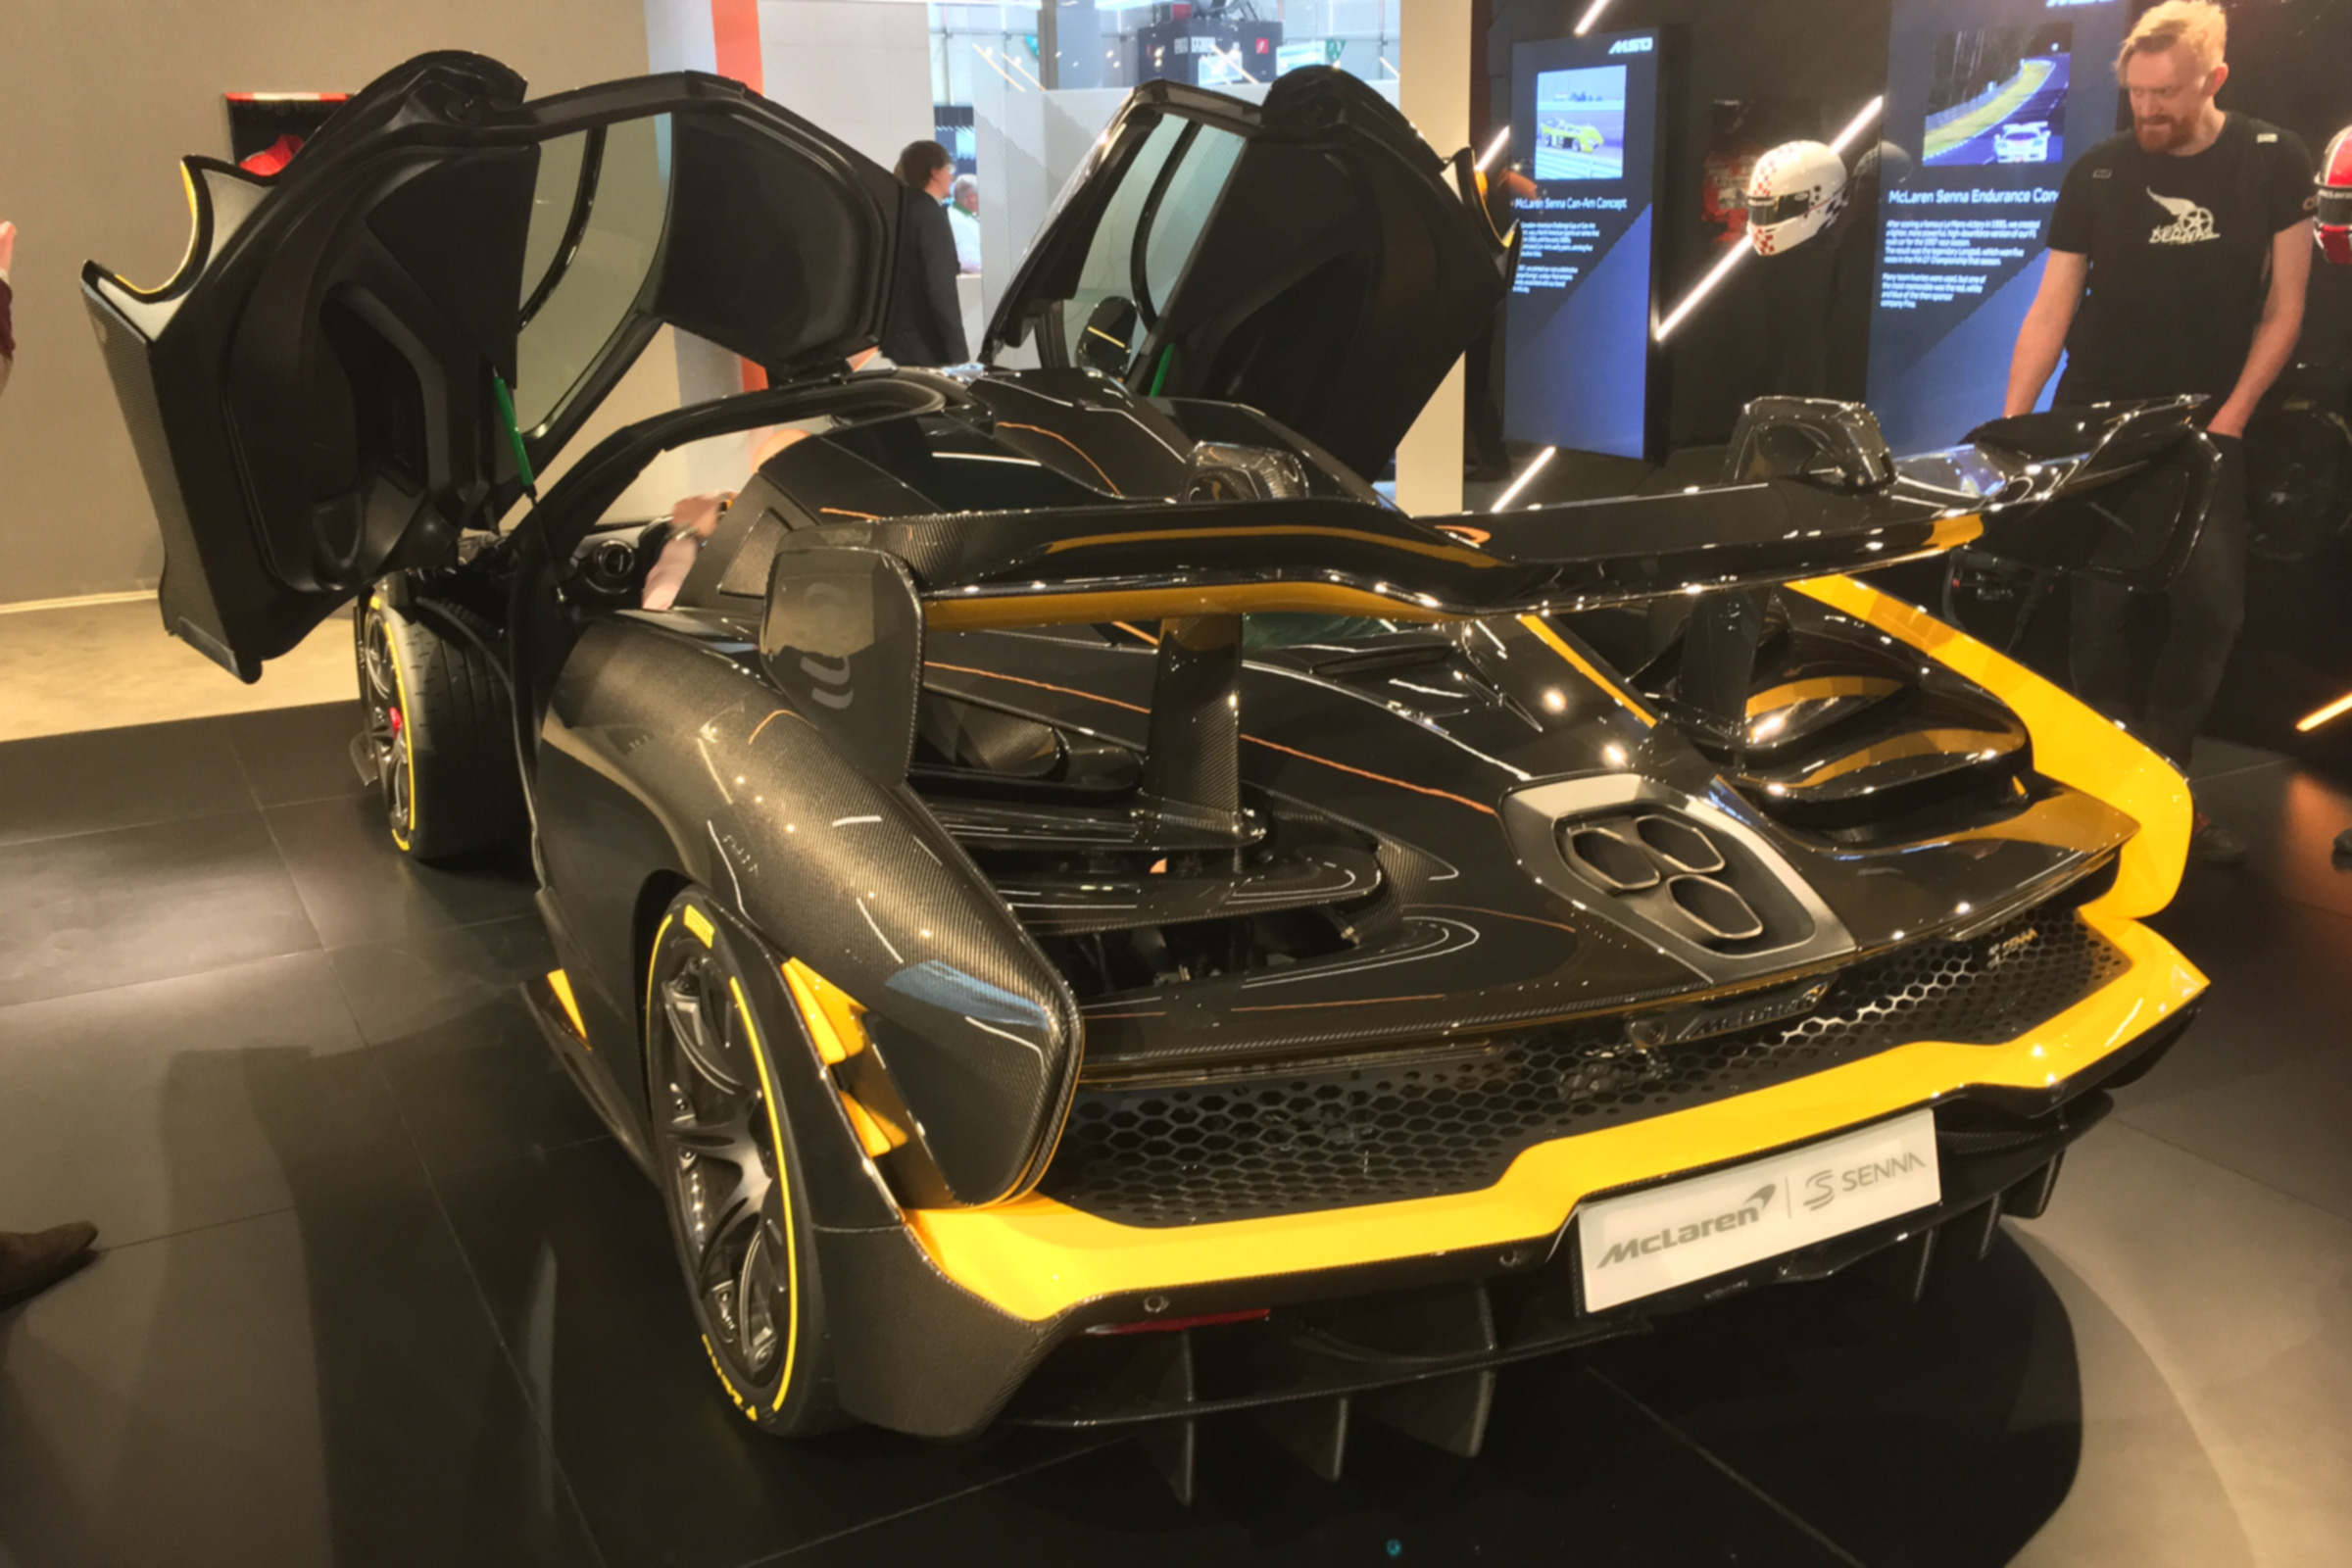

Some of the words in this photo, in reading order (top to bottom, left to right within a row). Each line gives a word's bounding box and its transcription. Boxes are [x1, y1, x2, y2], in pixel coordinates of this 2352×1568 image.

[1515, 198, 1544, 210] McLaren
[1544, 198, 1566, 210] Senna
[1567, 197, 1595, 209] Can-Am
[1596, 197, 1628, 211] Concept
[1888, 190, 1934, 204] McLaren
[1936, 188, 1969, 204] Senna
[1972, 188, 2031, 204] Endurance
[1596, 1204, 1759, 1269] McLaren
[1841, 1152, 1927, 1193] SENNA
